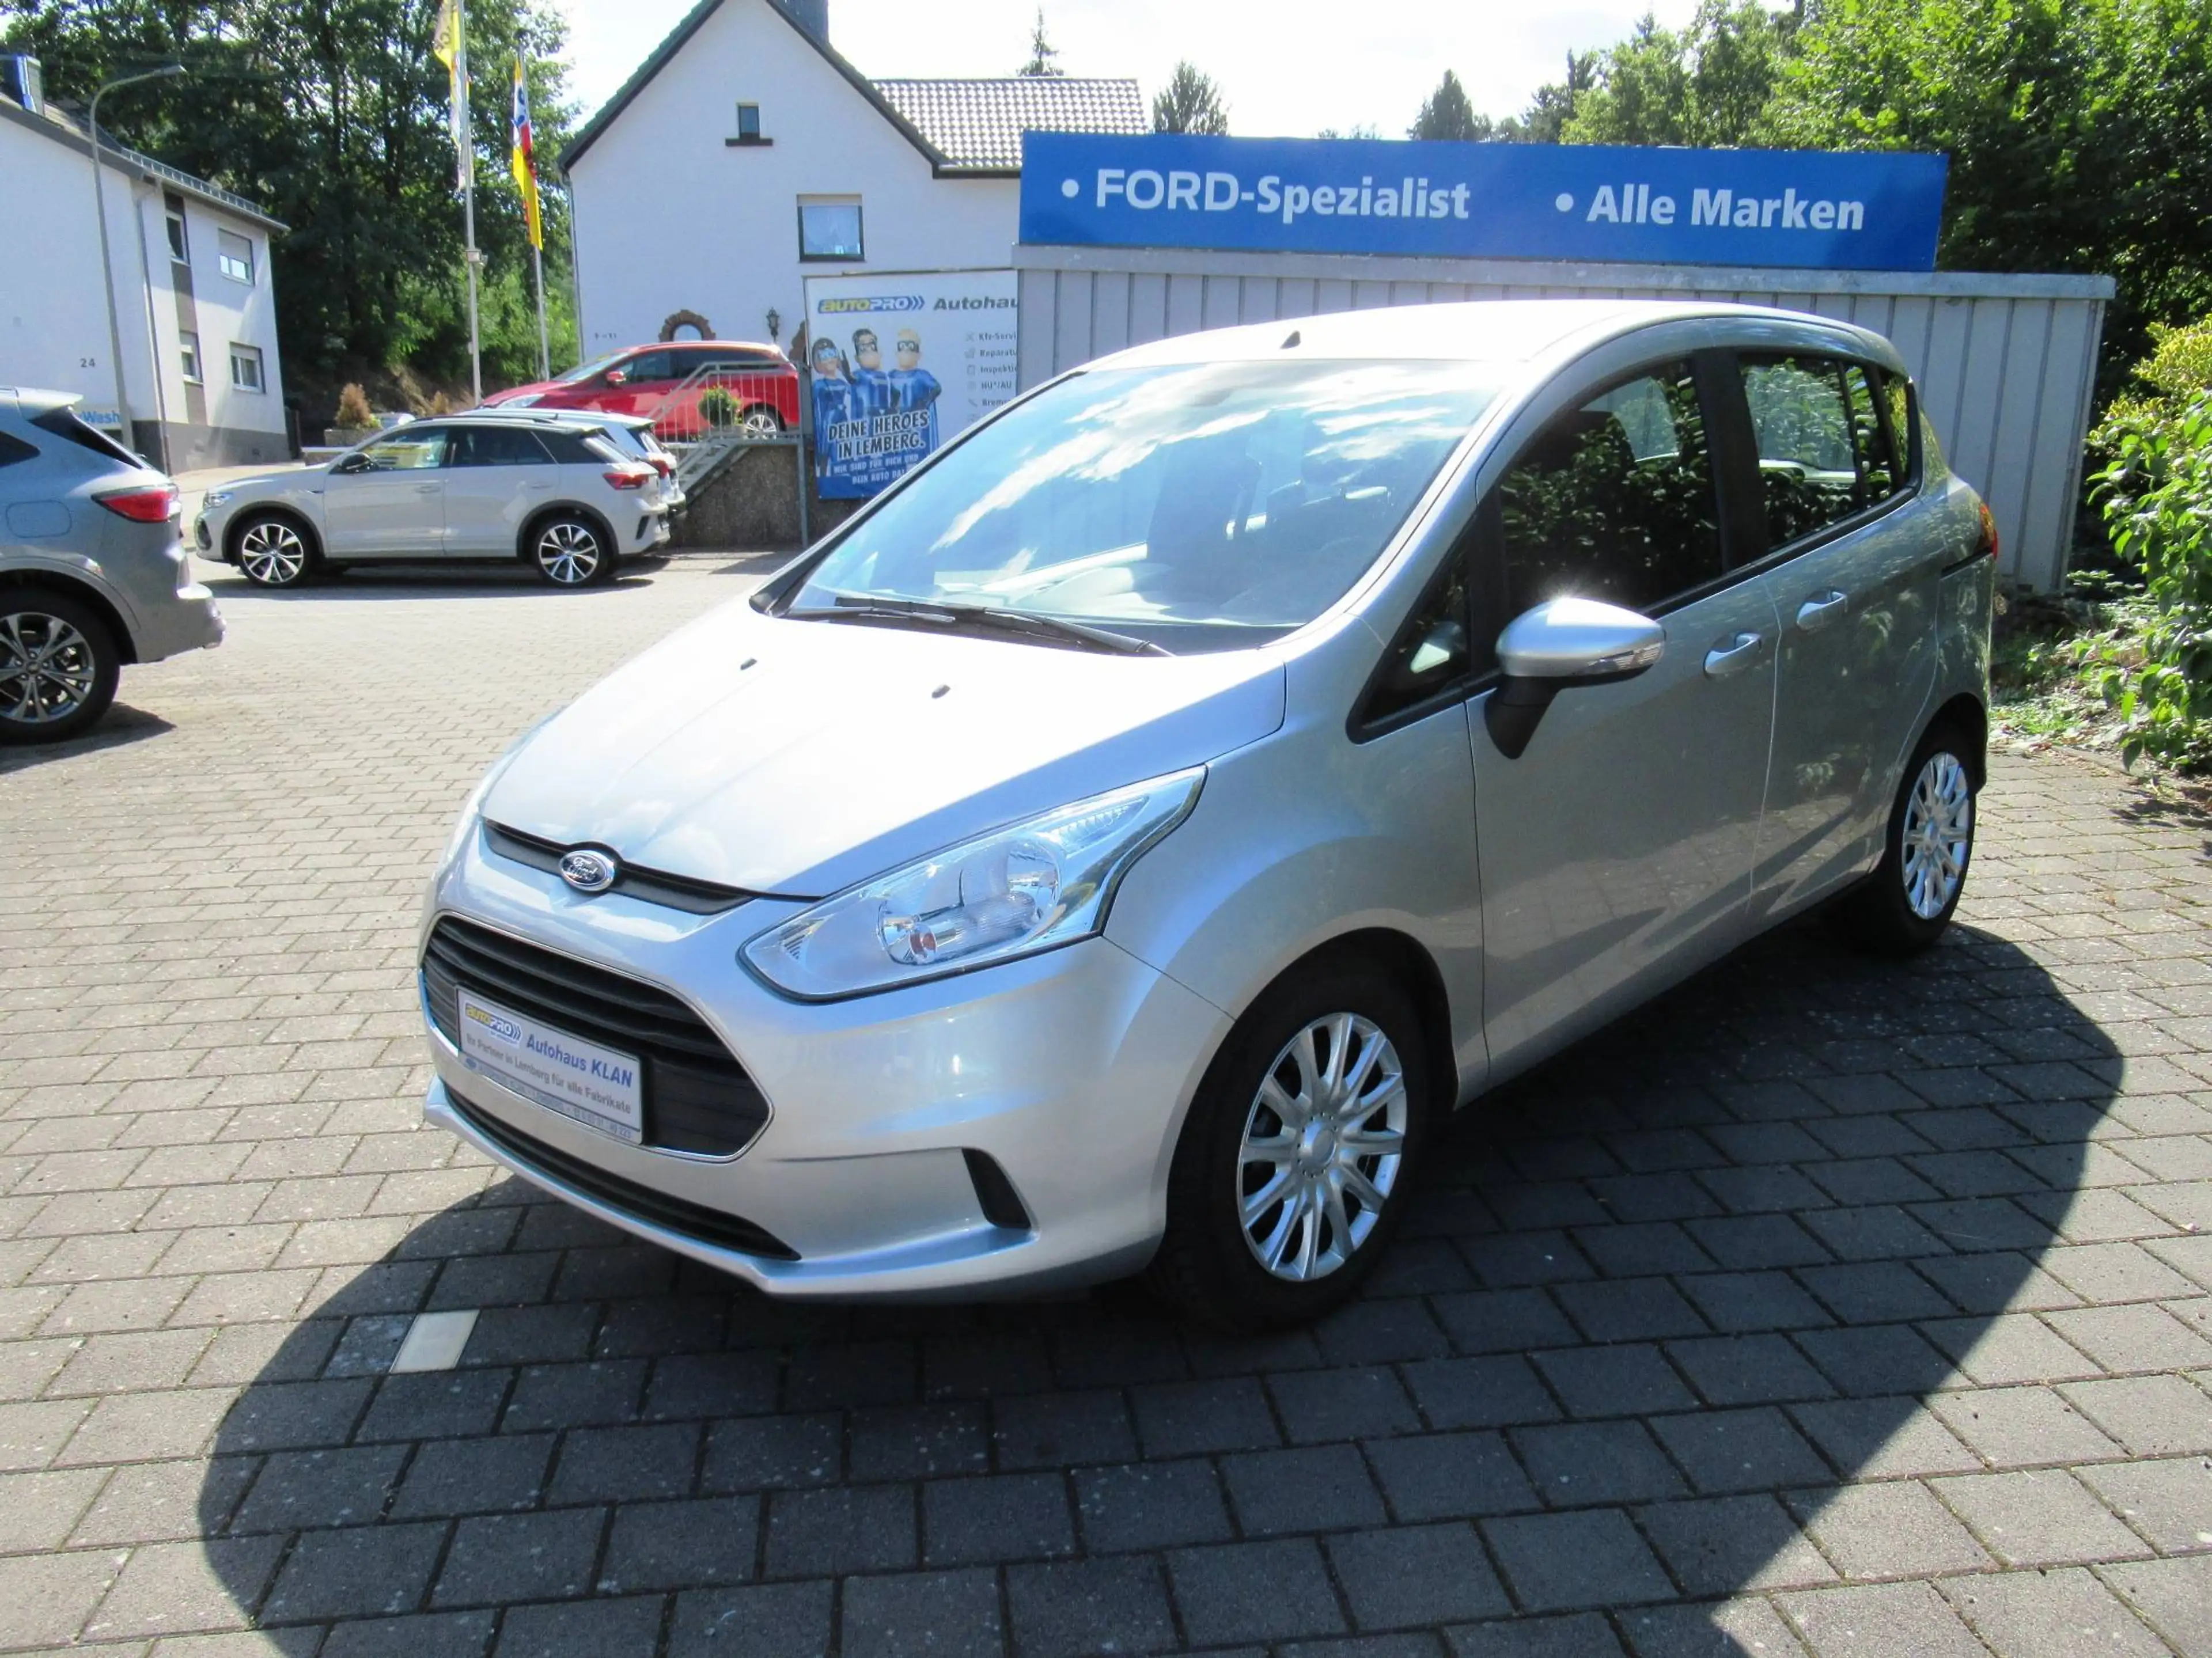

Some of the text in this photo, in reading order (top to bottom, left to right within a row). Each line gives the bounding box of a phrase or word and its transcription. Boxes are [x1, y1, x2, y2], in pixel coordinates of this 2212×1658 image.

[1097, 168, 1471, 224] FORD-Spezialist
[1586, 184, 1864, 230] Alle Marken
[81, 358, 95, 367] 24
[828, 410, 929, 442] DEINE HEROES
[838, 432, 926, 459] IN LEMBERG.
[871, 472, 890, 482] AUTO
[477, 1038, 505, 1058] Partner
[515, 1056, 551, 1084] Lemberg
[551, 1072, 565, 1088] für
[566, 1080, 584, 1096] alle
[585, 1087, 632, 1114] Fabrikate
[527, 1033, 586, 1071] Autohaus
[591, 1058, 632, 1088] KLAN
